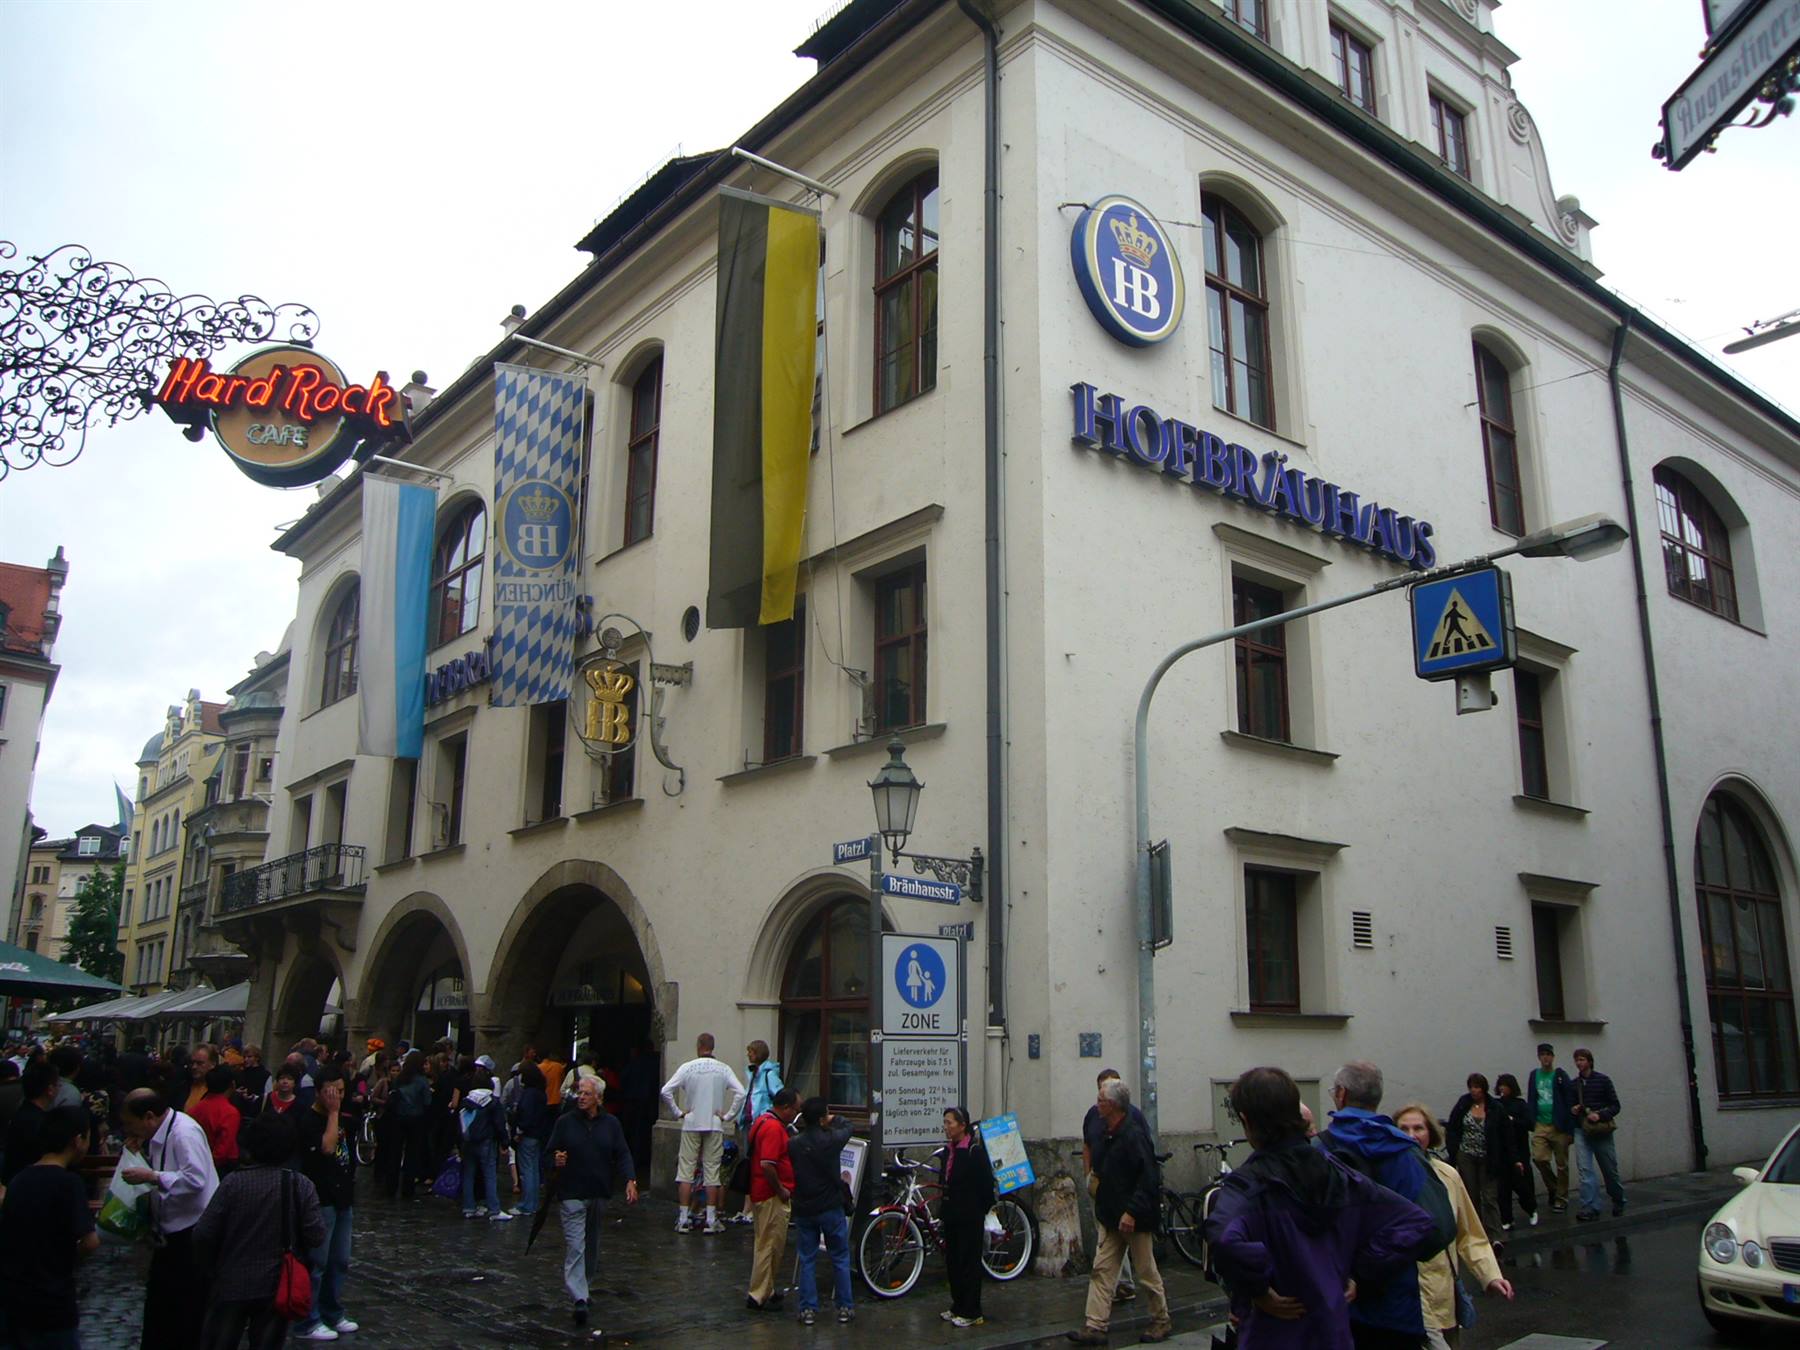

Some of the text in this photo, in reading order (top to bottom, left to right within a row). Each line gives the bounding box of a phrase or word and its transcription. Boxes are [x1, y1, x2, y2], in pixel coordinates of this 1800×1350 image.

[1112, 257, 1160, 319] HB
[162, 357, 395, 427] Hard Rock
[1070, 381, 1437, 569] HOFBRÄUHAUS
[838, 840, 865, 859] Platzl
[889, 877, 955, 900] Bräuhausstr.
[901, 1013, 940, 1029] ZONE
[893, 1047, 938, 1055] Lieferverkehr
[890, 1058, 925, 1067] Fahrzeuge
[927, 1058, 937, 1066] bis
[898, 1086, 926, 1096] Sonntag
[898, 1097, 928, 1106] Samstag
[894, 1126, 930, 1136] Feiertagen
